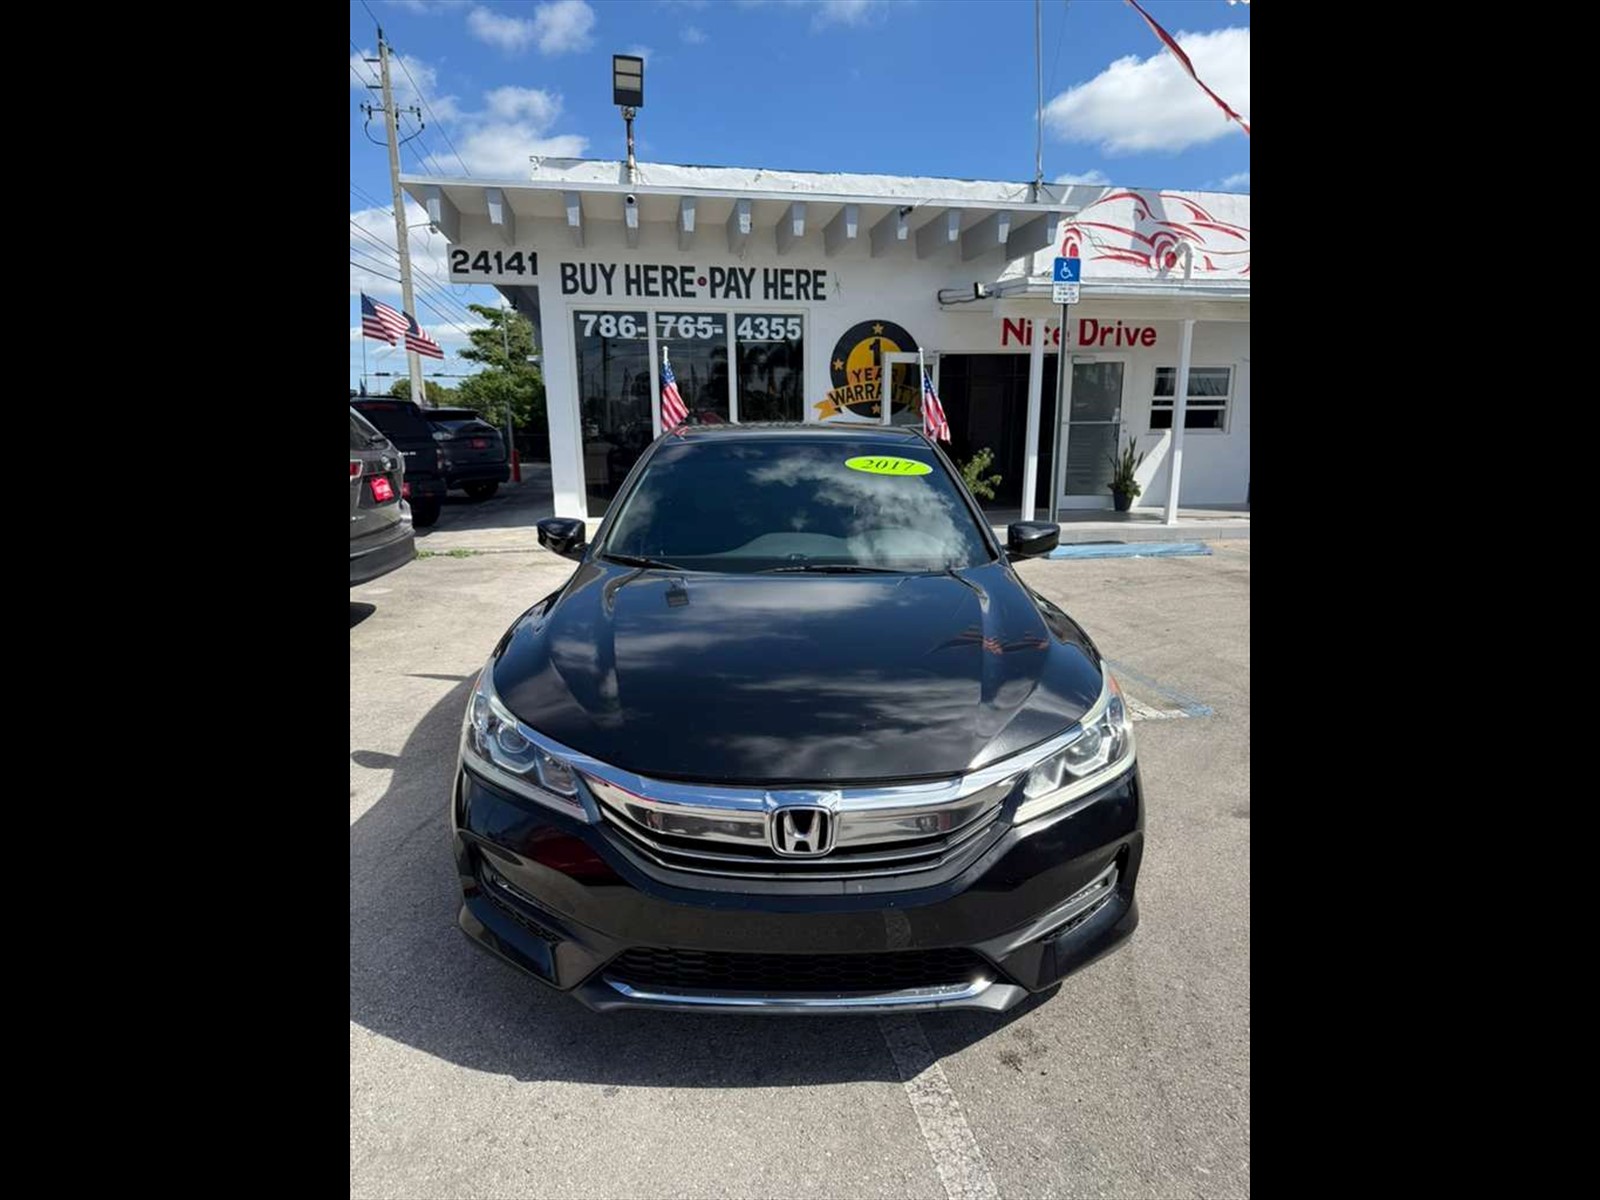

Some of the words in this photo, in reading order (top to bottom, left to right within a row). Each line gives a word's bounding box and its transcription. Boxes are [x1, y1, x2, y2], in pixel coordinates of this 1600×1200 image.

[451, 250, 538, 275] 24141
[560, 263, 616, 295] BUY
[624, 264, 697, 298] HERE
[709, 266, 756, 299] PAY
[763, 268, 827, 300] HERE
[579, 313, 647, 338] 786-
[658, 315, 724, 339] 765-
[737, 317, 801, 340] 4355
[1002, 317, 1070, 346] Nie
[1079, 318, 1157, 346] Drive
[869, 338, 881, 366] 1
[861, 459, 915, 471] 2017
